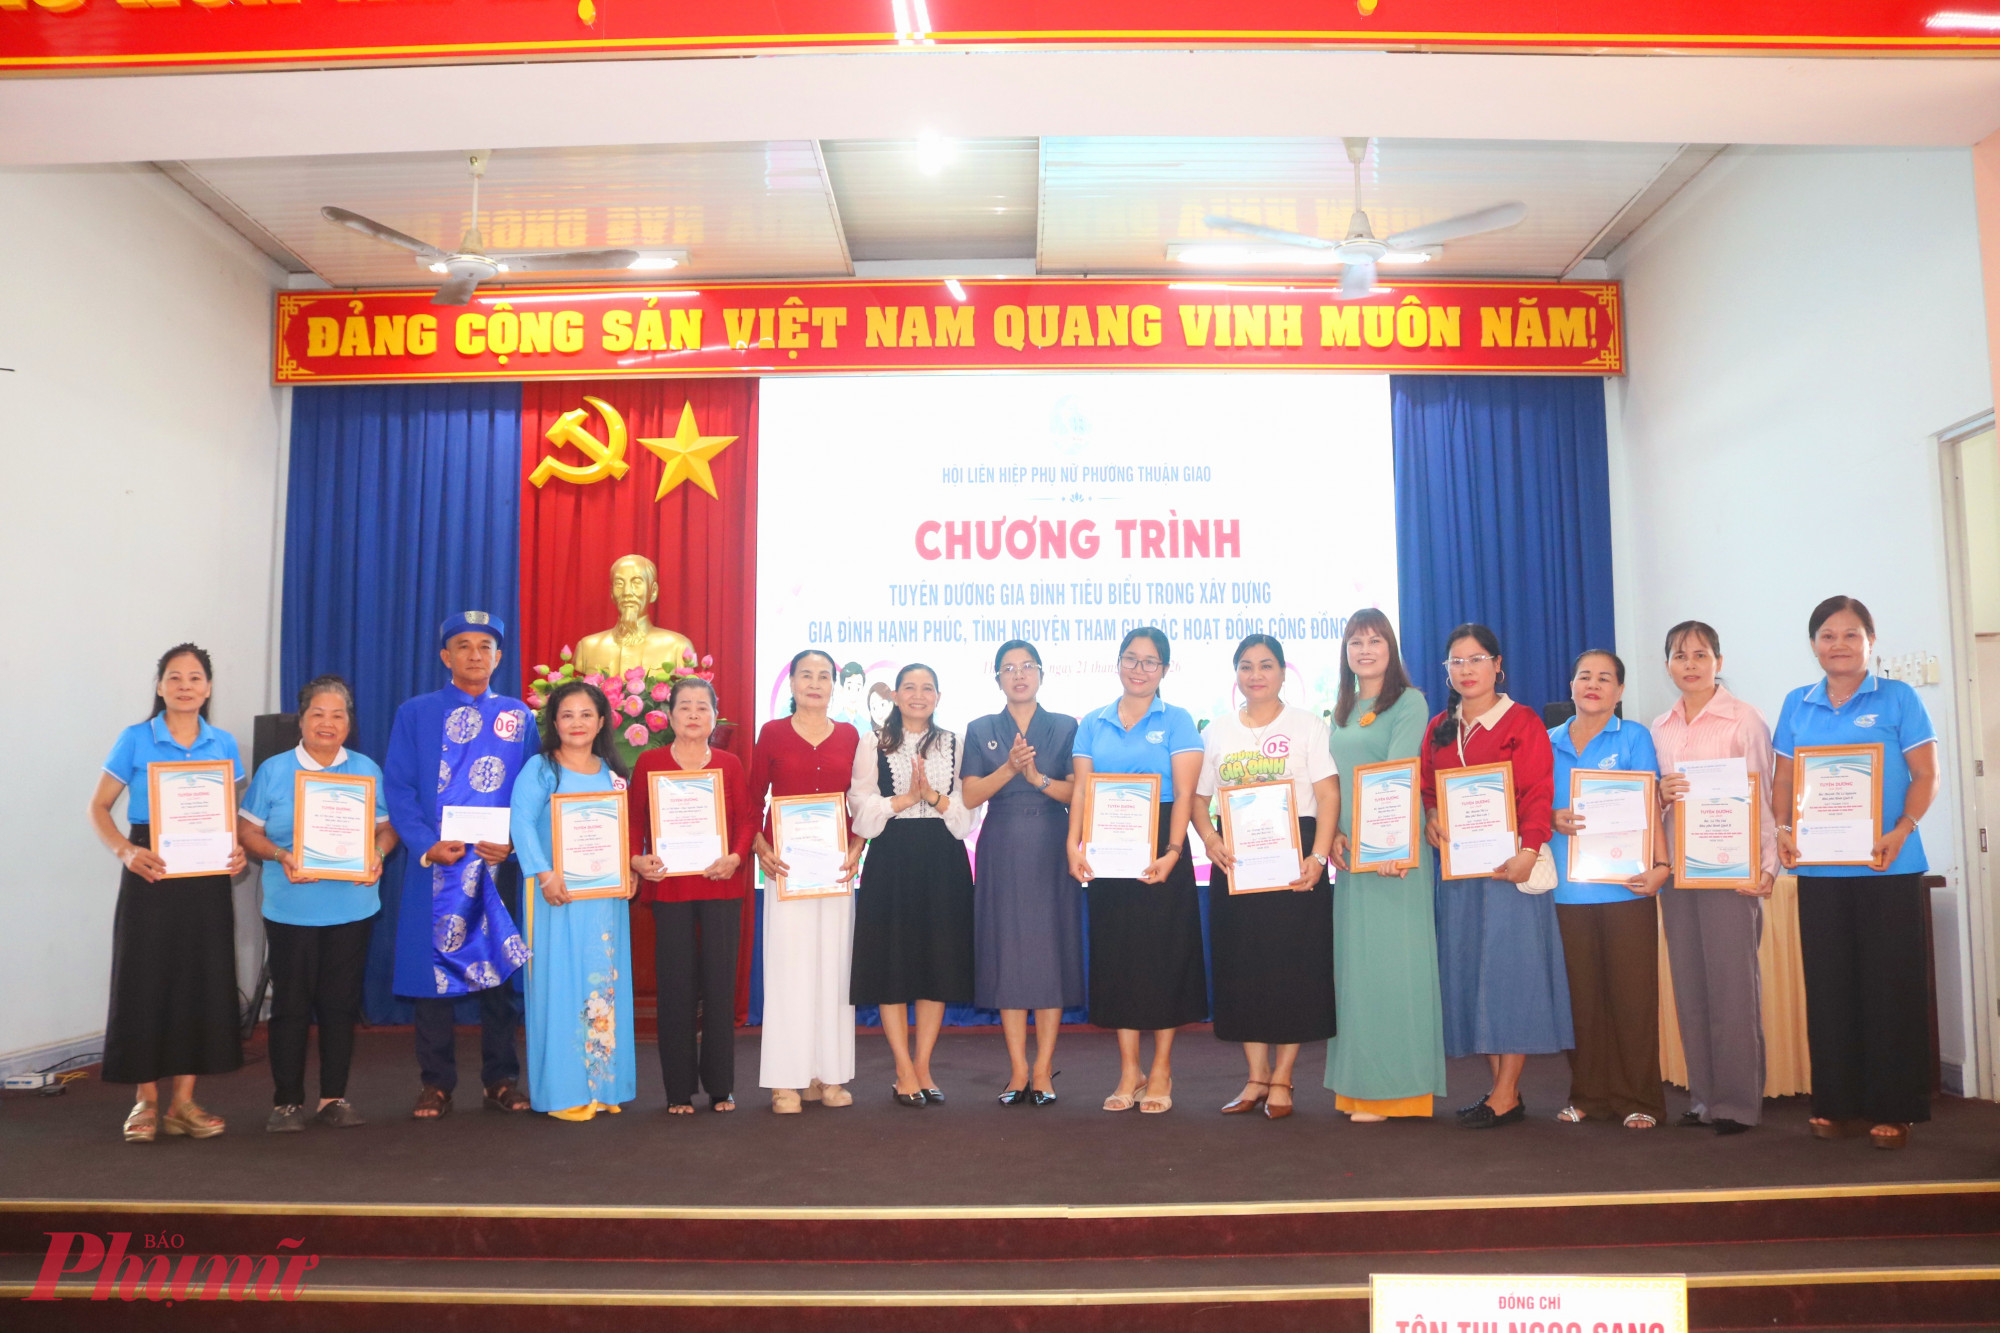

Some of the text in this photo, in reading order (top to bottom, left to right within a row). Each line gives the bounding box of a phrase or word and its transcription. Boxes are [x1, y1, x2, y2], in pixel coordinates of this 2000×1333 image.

[308, 295, 1597, 365] ĐẢNG CỘNG SẢN VIỆT NAM QUANG VINH MUÔN NĂM!
[943, 463, 963, 487] HỘI
[1000, 463, 1028, 487] HIỆP
[1032, 463, 1056, 487] PHỤ
[1061, 463, 1080, 483] NỮ
[1138, 463, 1179, 486] THUẬN
[1184, 463, 1211, 482] GIAO
[915, 510, 1241, 561] CHƯƠNG TRÌNH
[888, 574, 1272, 609] TUYÊN DƯƠNG GIA ĐÌNH TIÊU BIỂU TRONG XÂY DỰNG
[808, 621, 833, 644] GIA
[838, 616, 873, 643] ĐÌNH
[879, 620, 918, 647] HẠNH
[924, 615, 968, 645] PHÚC,
[973, 615, 1006, 642] TÌNH
[1012, 615, 1070, 646] NGUYỆN
[1075, 618, 1117, 641] THAM
[1184, 618, 1221, 645] HOẠT
[1269, 613, 1307, 644] CỘNG
[495, 717, 515, 733] 06
[1267, 741, 1289, 754] 05
[1219, 755, 1286, 782] GIA ĐÌNH
